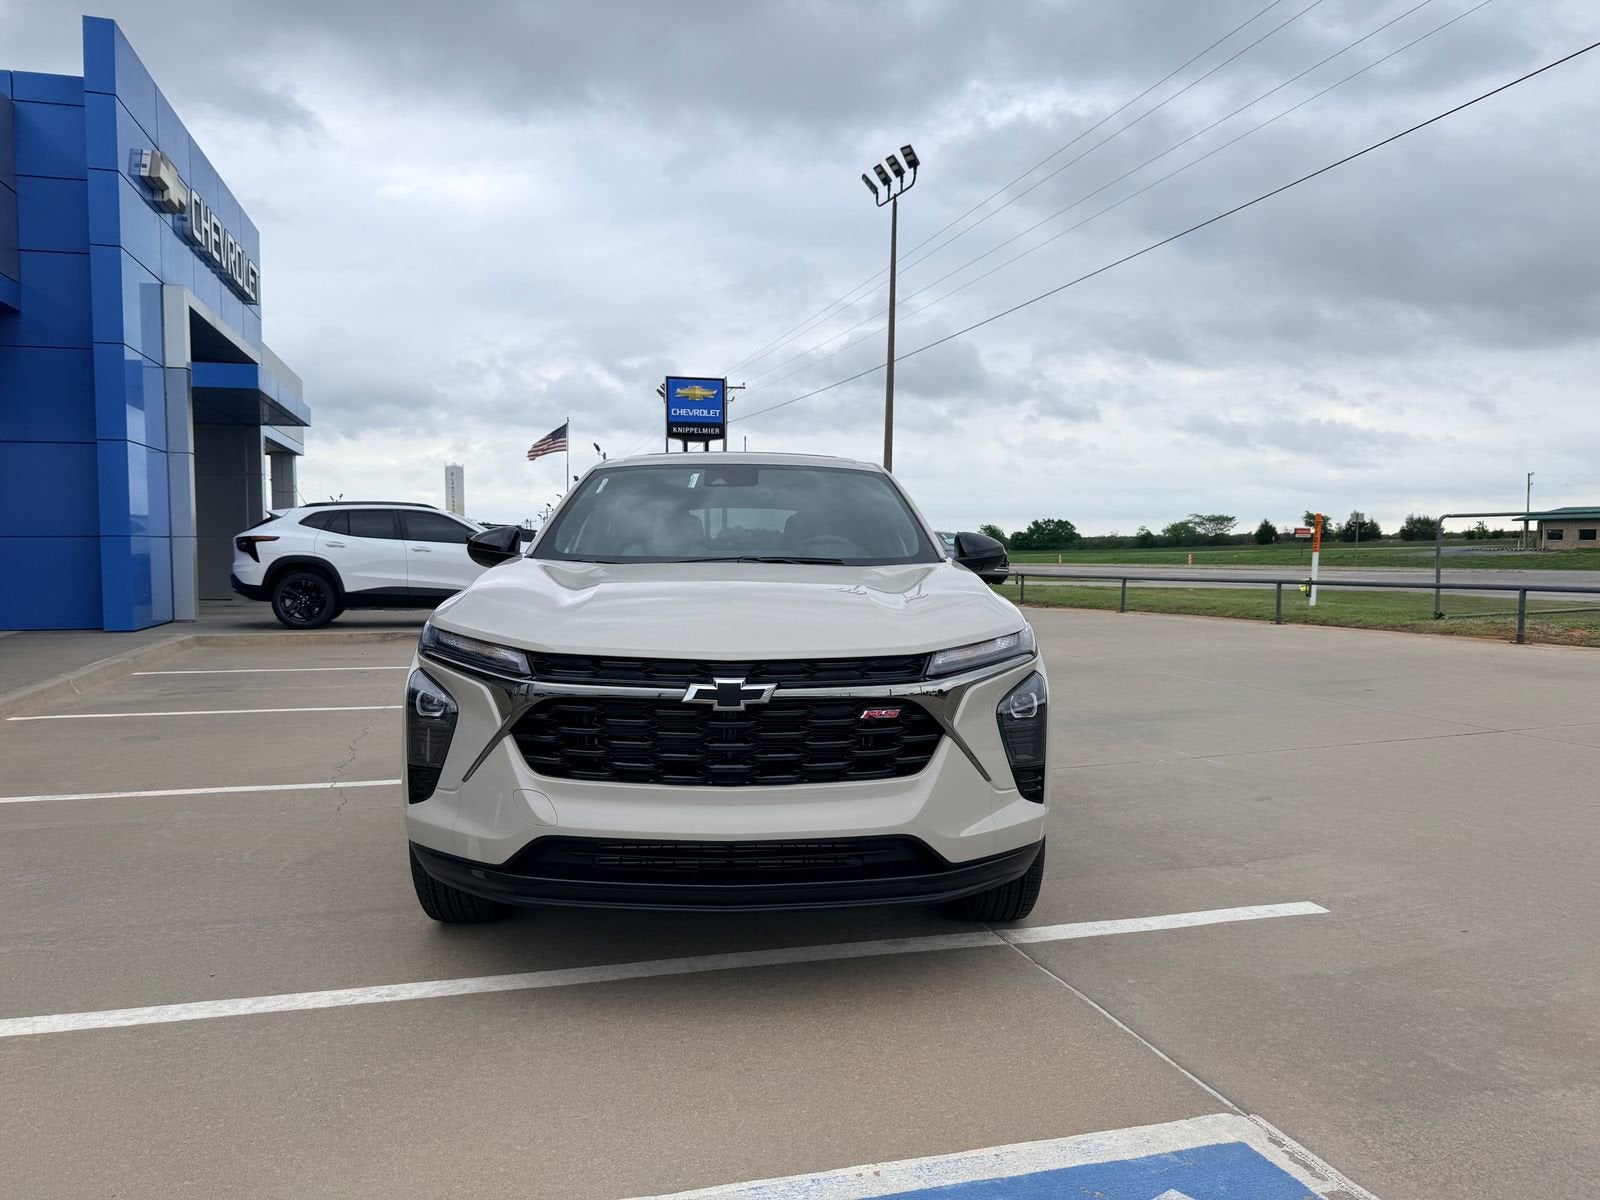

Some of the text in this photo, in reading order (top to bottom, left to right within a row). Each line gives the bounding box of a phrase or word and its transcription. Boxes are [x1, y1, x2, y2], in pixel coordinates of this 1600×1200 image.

[191, 188, 260, 305] CHEVROLET
[671, 408, 721, 417] CHEVROLET
[672, 426, 720, 435] KNIPPELMIER
[860, 709, 901, 719] RS
